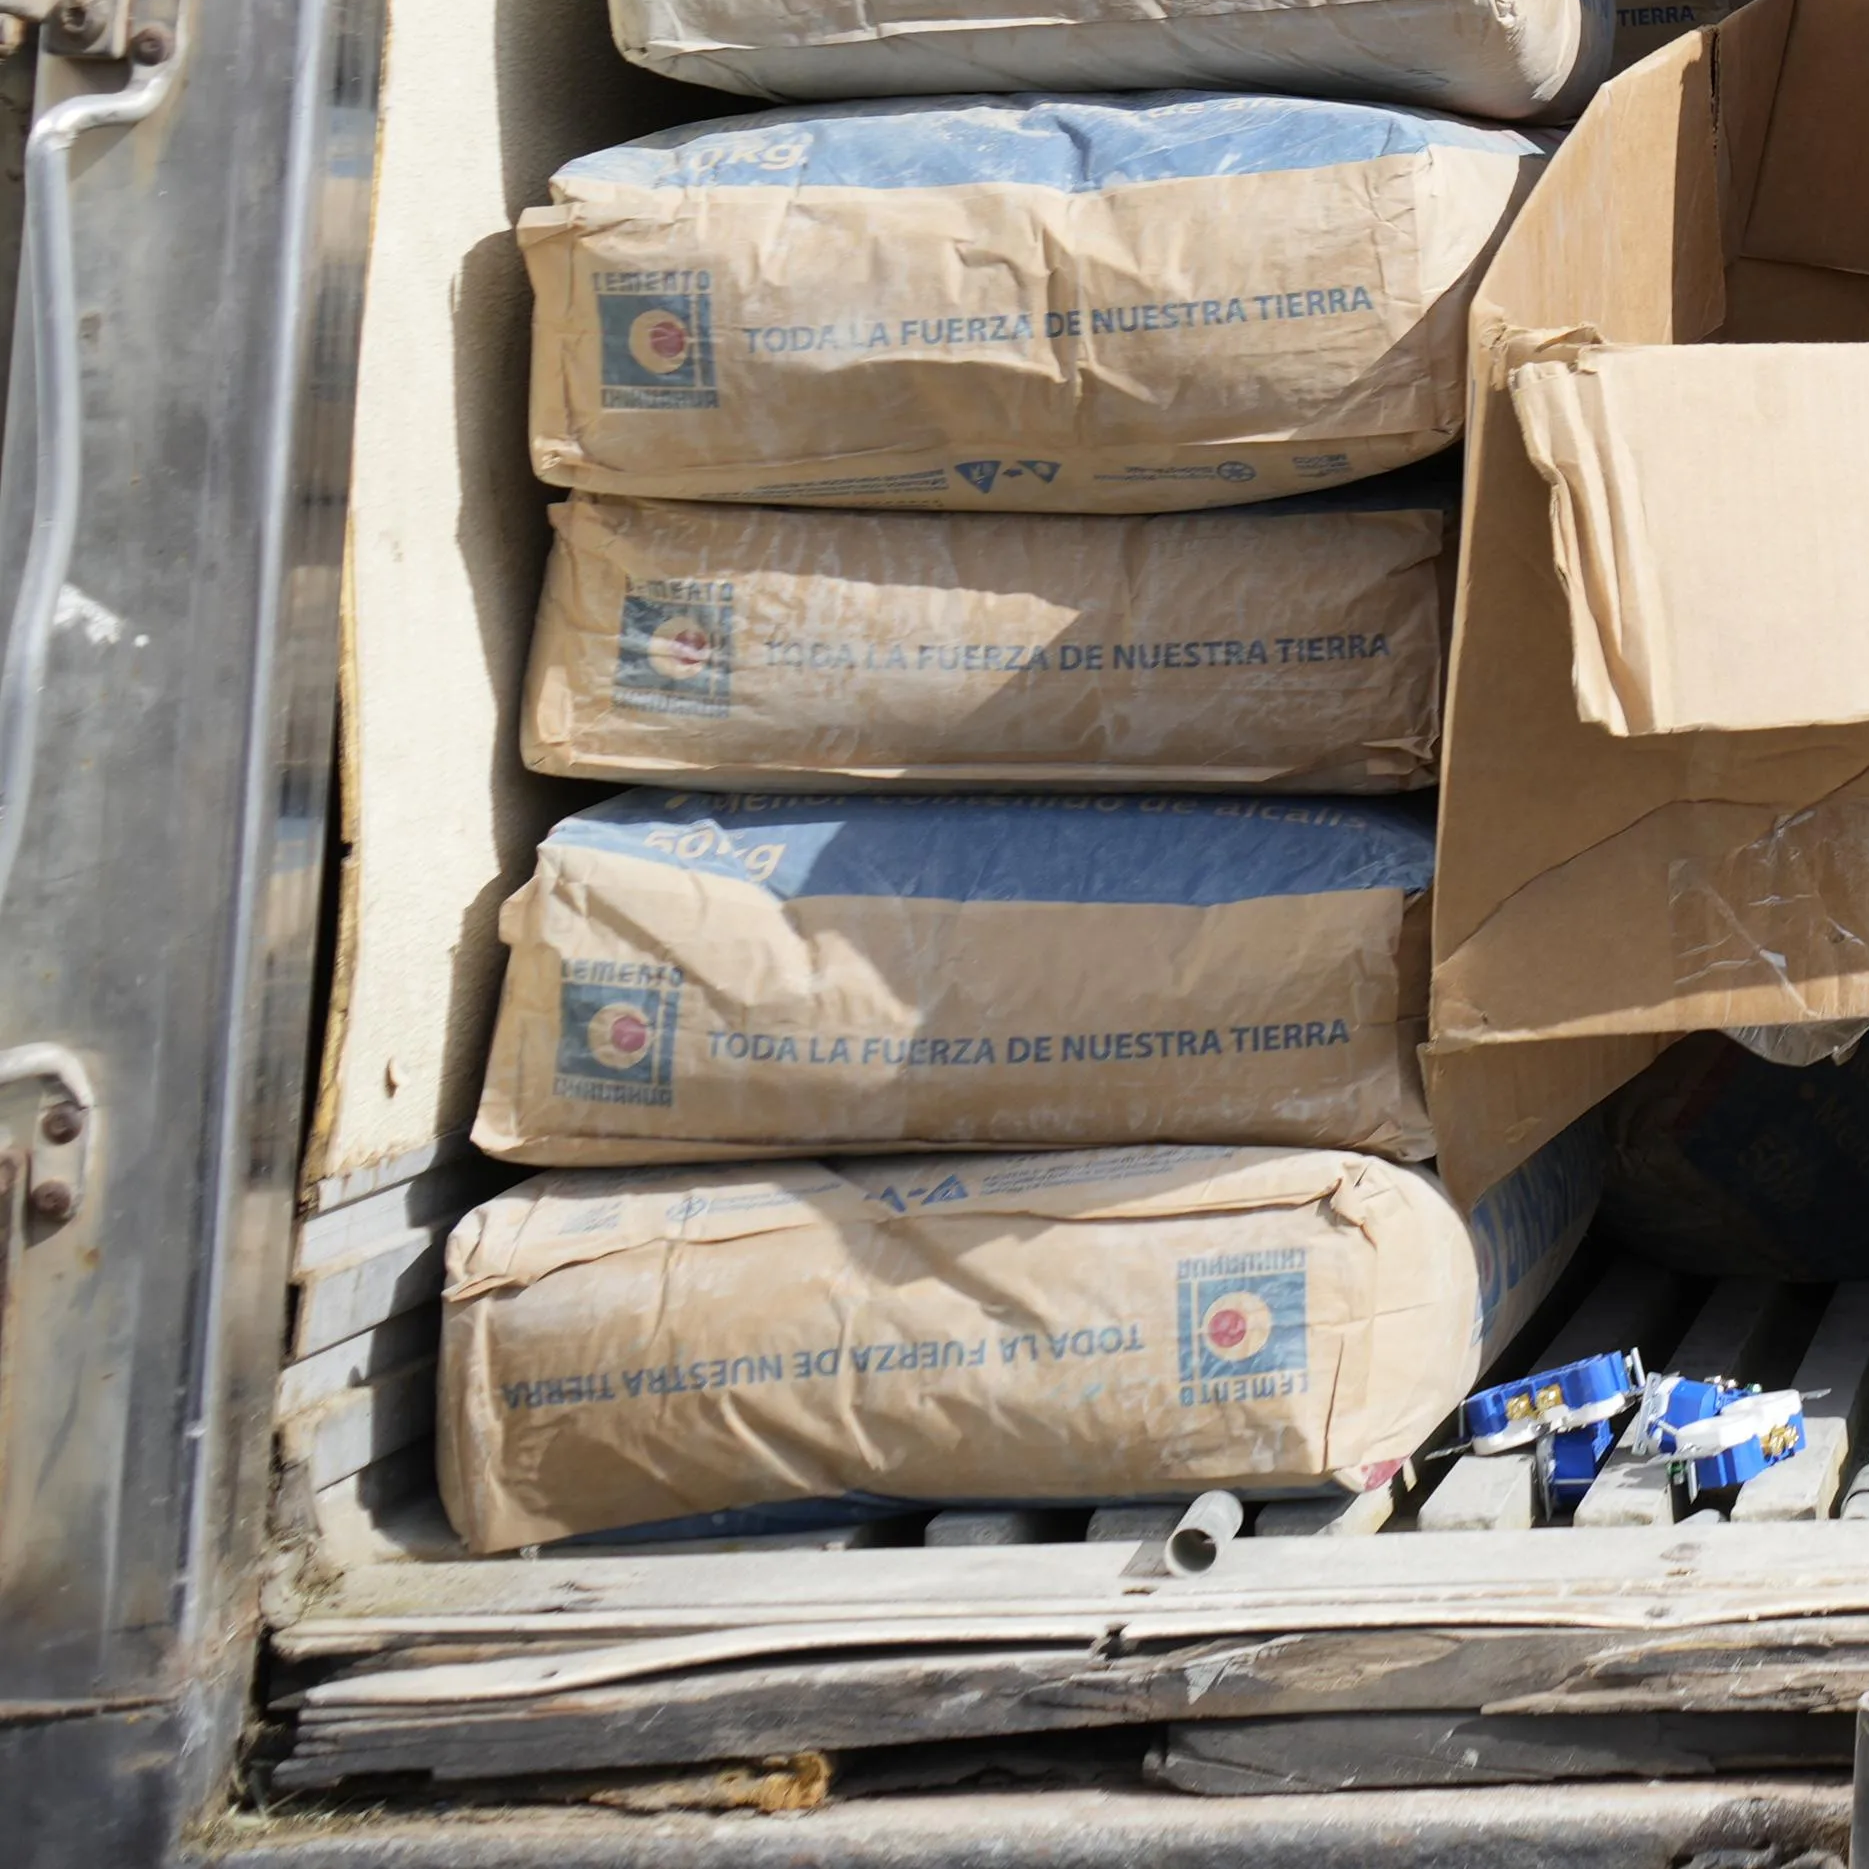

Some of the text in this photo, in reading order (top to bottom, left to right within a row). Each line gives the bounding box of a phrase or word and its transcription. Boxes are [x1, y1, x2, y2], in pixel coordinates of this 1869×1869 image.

[1617, 4, 1695, 27] TIERRA
[743, 322, 846, 355] TODA
[899, 310, 1034, 347] FUERZA
[1044, 309, 1081, 339] DE
[1091, 297, 1249, 334] NUESTRA
[1254, 284, 1374, 320] TIERRA
[764, 632, 1391, 673] TODA LA FUERZA DE NUESTRA TIERRA
[707, 1019, 1350, 1066] TODA LA FUERZA DE NUESTRA TIERRA
[499, 1323, 1147, 1412] TODA LA FUERZA DE NUESTRA TIERRA
